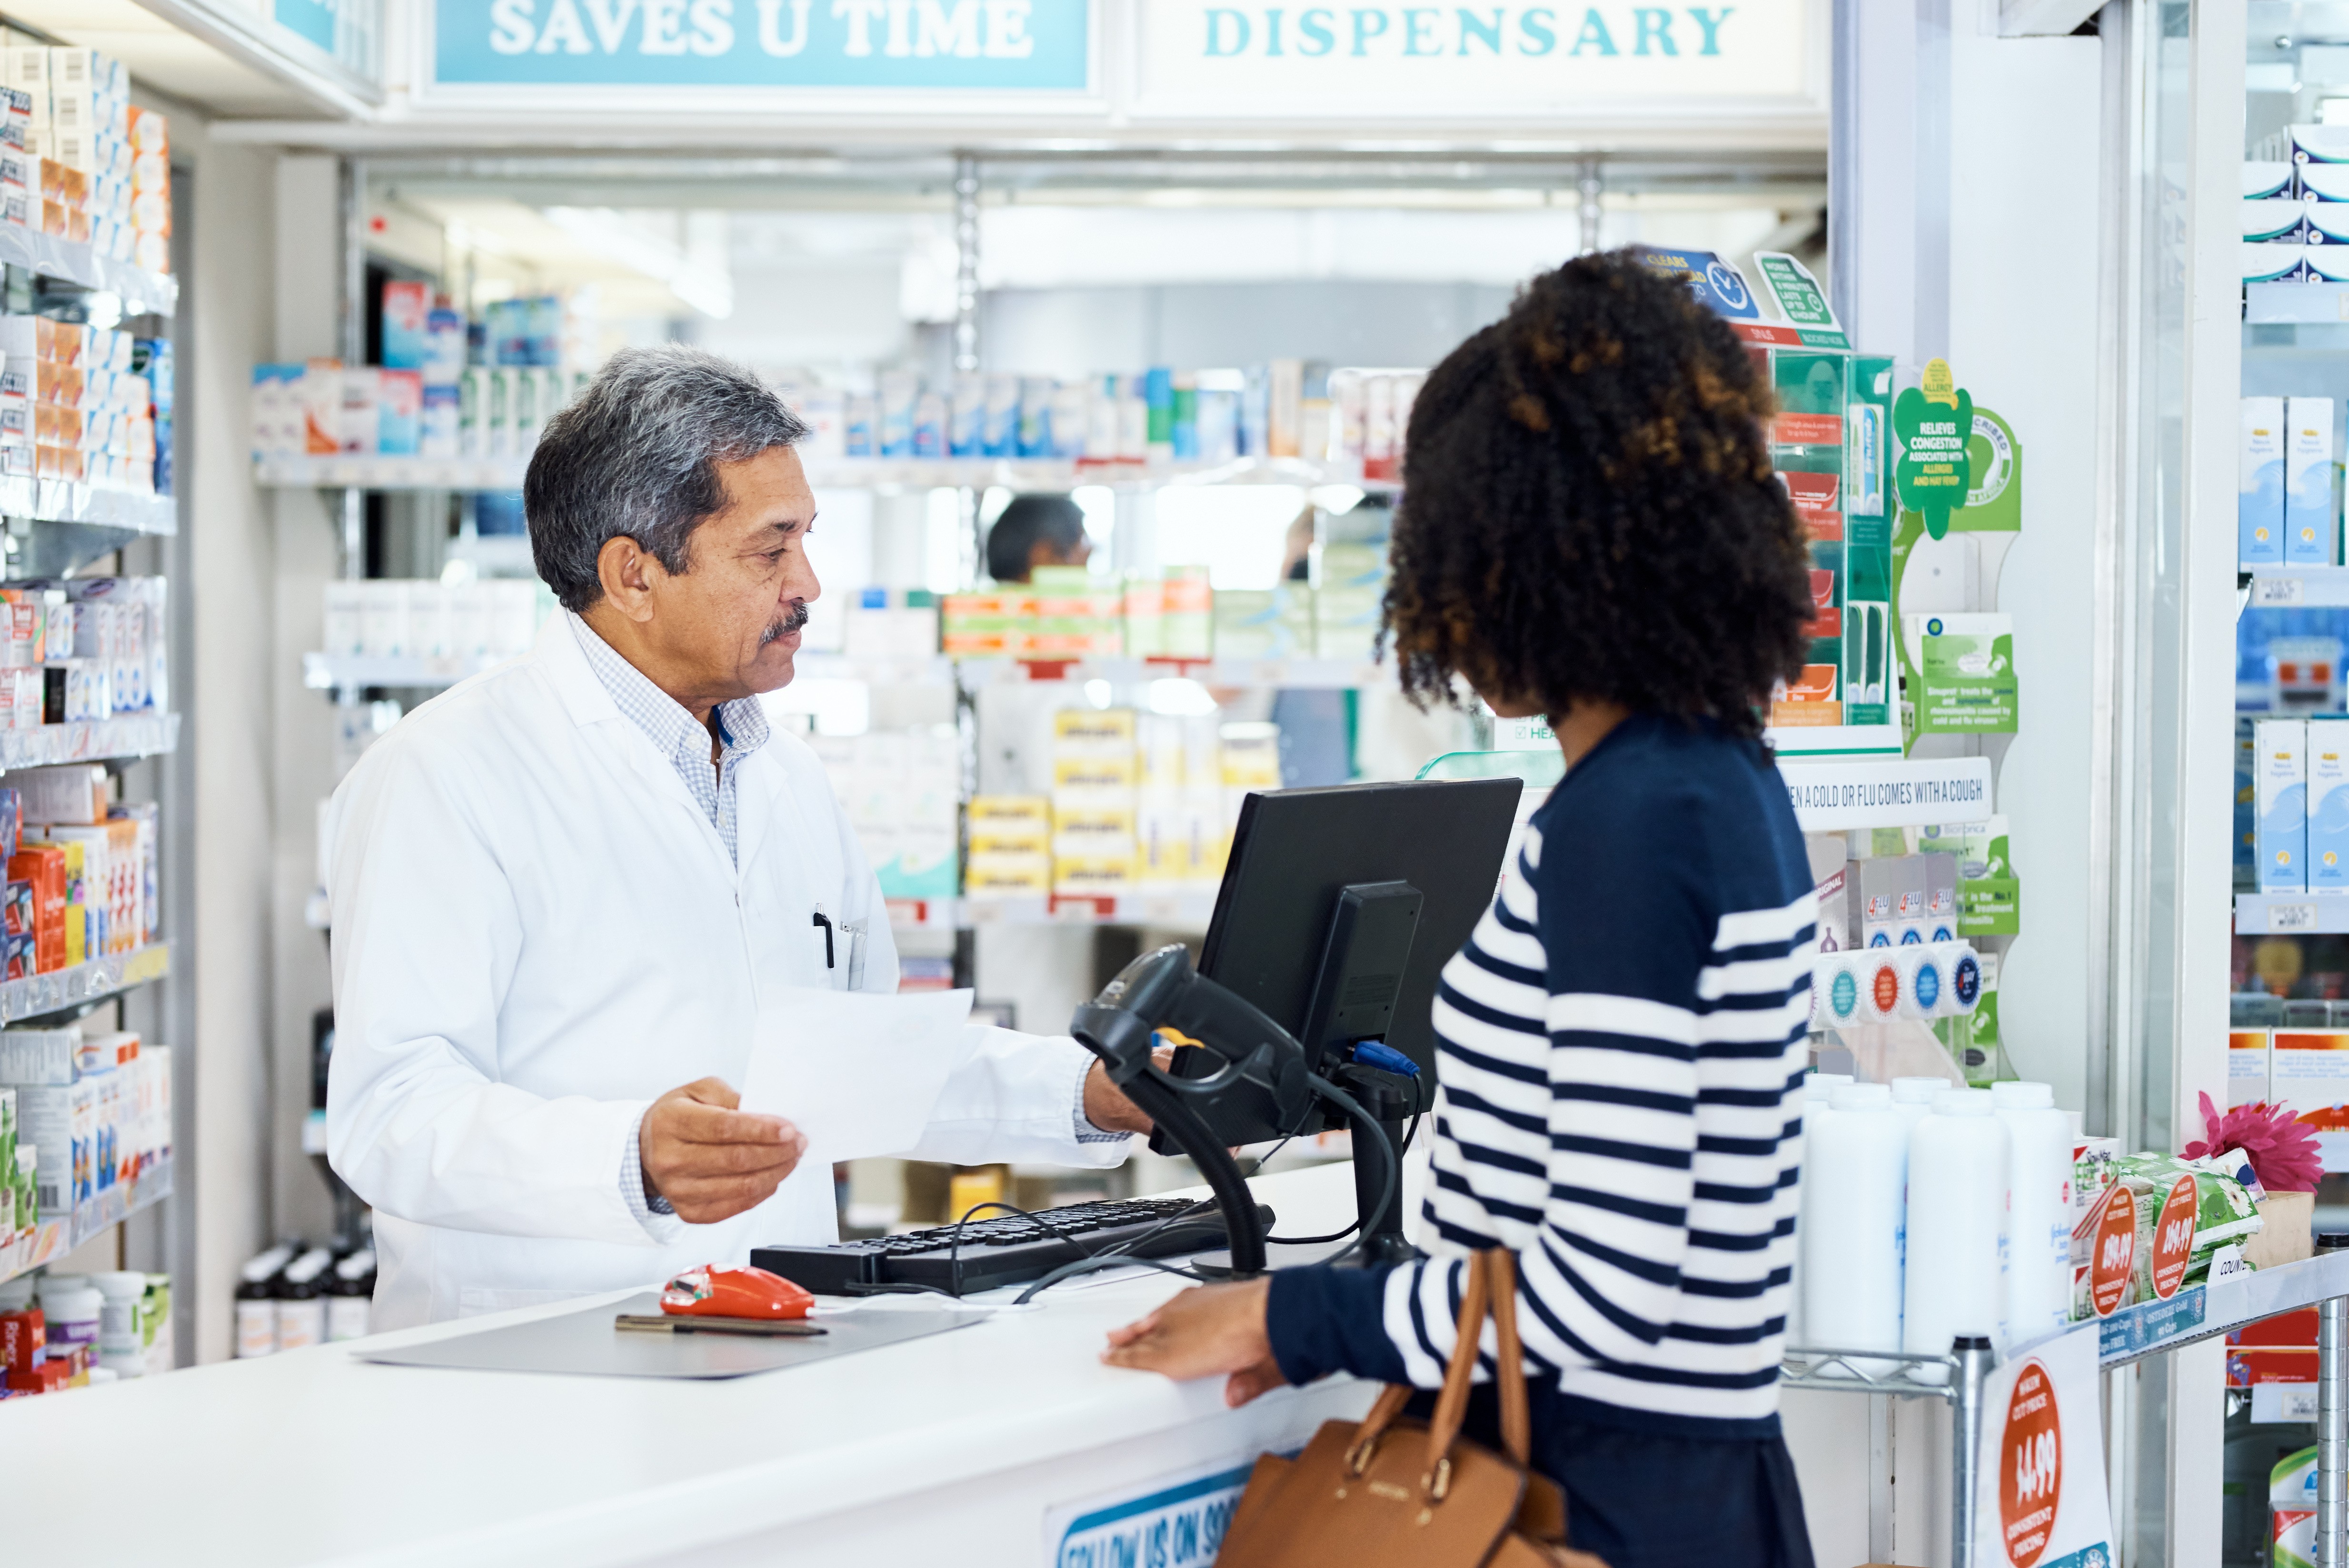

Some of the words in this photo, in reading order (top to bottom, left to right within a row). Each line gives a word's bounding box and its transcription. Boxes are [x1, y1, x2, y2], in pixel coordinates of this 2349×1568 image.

[488, 0, 736, 57] SAVES
[756, 0, 810, 58] U
[831, 0, 1035, 59] TIME
[1201, 6, 1736, 58] DISPENSARY
[1920, 422, 1956, 435] RELIEVES
[1909, 451, 1948, 462] ASSOCIATED
[1949, 451, 1963, 462] WITH
[1910, 437, 1962, 450] CONGESTION
[1913, 476, 1928, 486] AND
[1929, 476, 1941, 486] HAY
[1531, 727, 1556, 739] HEA
[1787, 785, 1802, 808] EN
[1805, 786, 1811, 808] A
[1813, 784, 1838, 808] COLD
[1842, 784, 1855, 807] OR
[1857, 783, 1876, 807] FLU
[1878, 782, 1912, 806] COMES
[1914, 781, 1940, 804] WITH
[1941, 780, 1948, 803] A
[1950, 778, 1983, 802] COUGH
[2007, 1505, 2052, 1541] CONSISTENT
[1145, 1516, 1169, 1568] US
[1174, 1508, 1200, 1565] ON
[2013, 1531, 2045, 1560] PRICING
